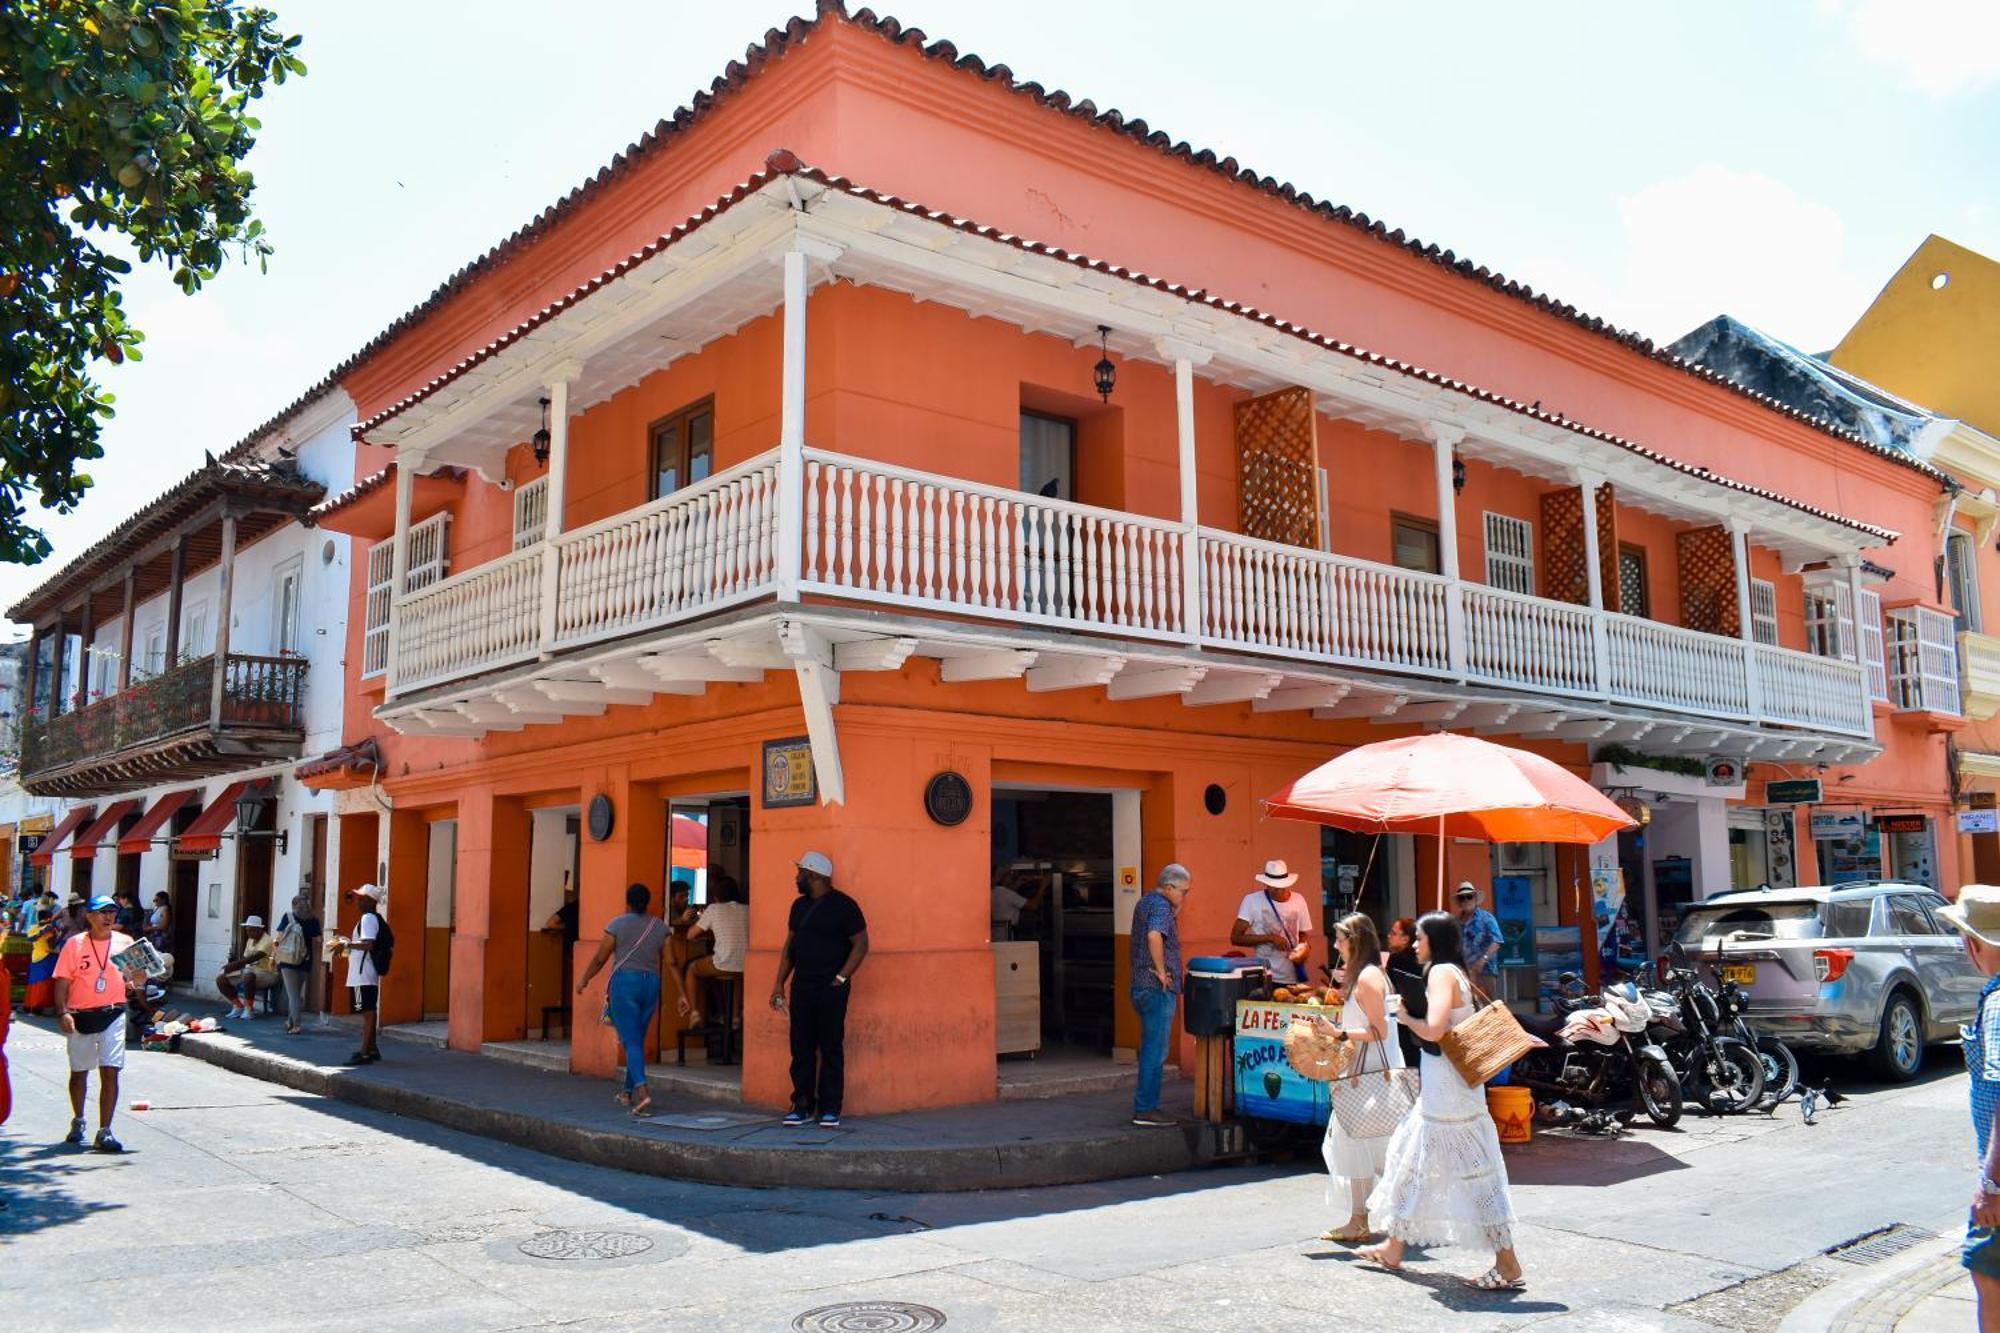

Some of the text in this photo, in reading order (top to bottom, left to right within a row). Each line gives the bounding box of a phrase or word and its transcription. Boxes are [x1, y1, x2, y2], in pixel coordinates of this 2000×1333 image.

[79, 955, 90, 970] 5
[1241, 1008, 1259, 1030] LA
[1263, 1010, 1280, 1030] FE
[1246, 1044, 1275, 1070] COCO
